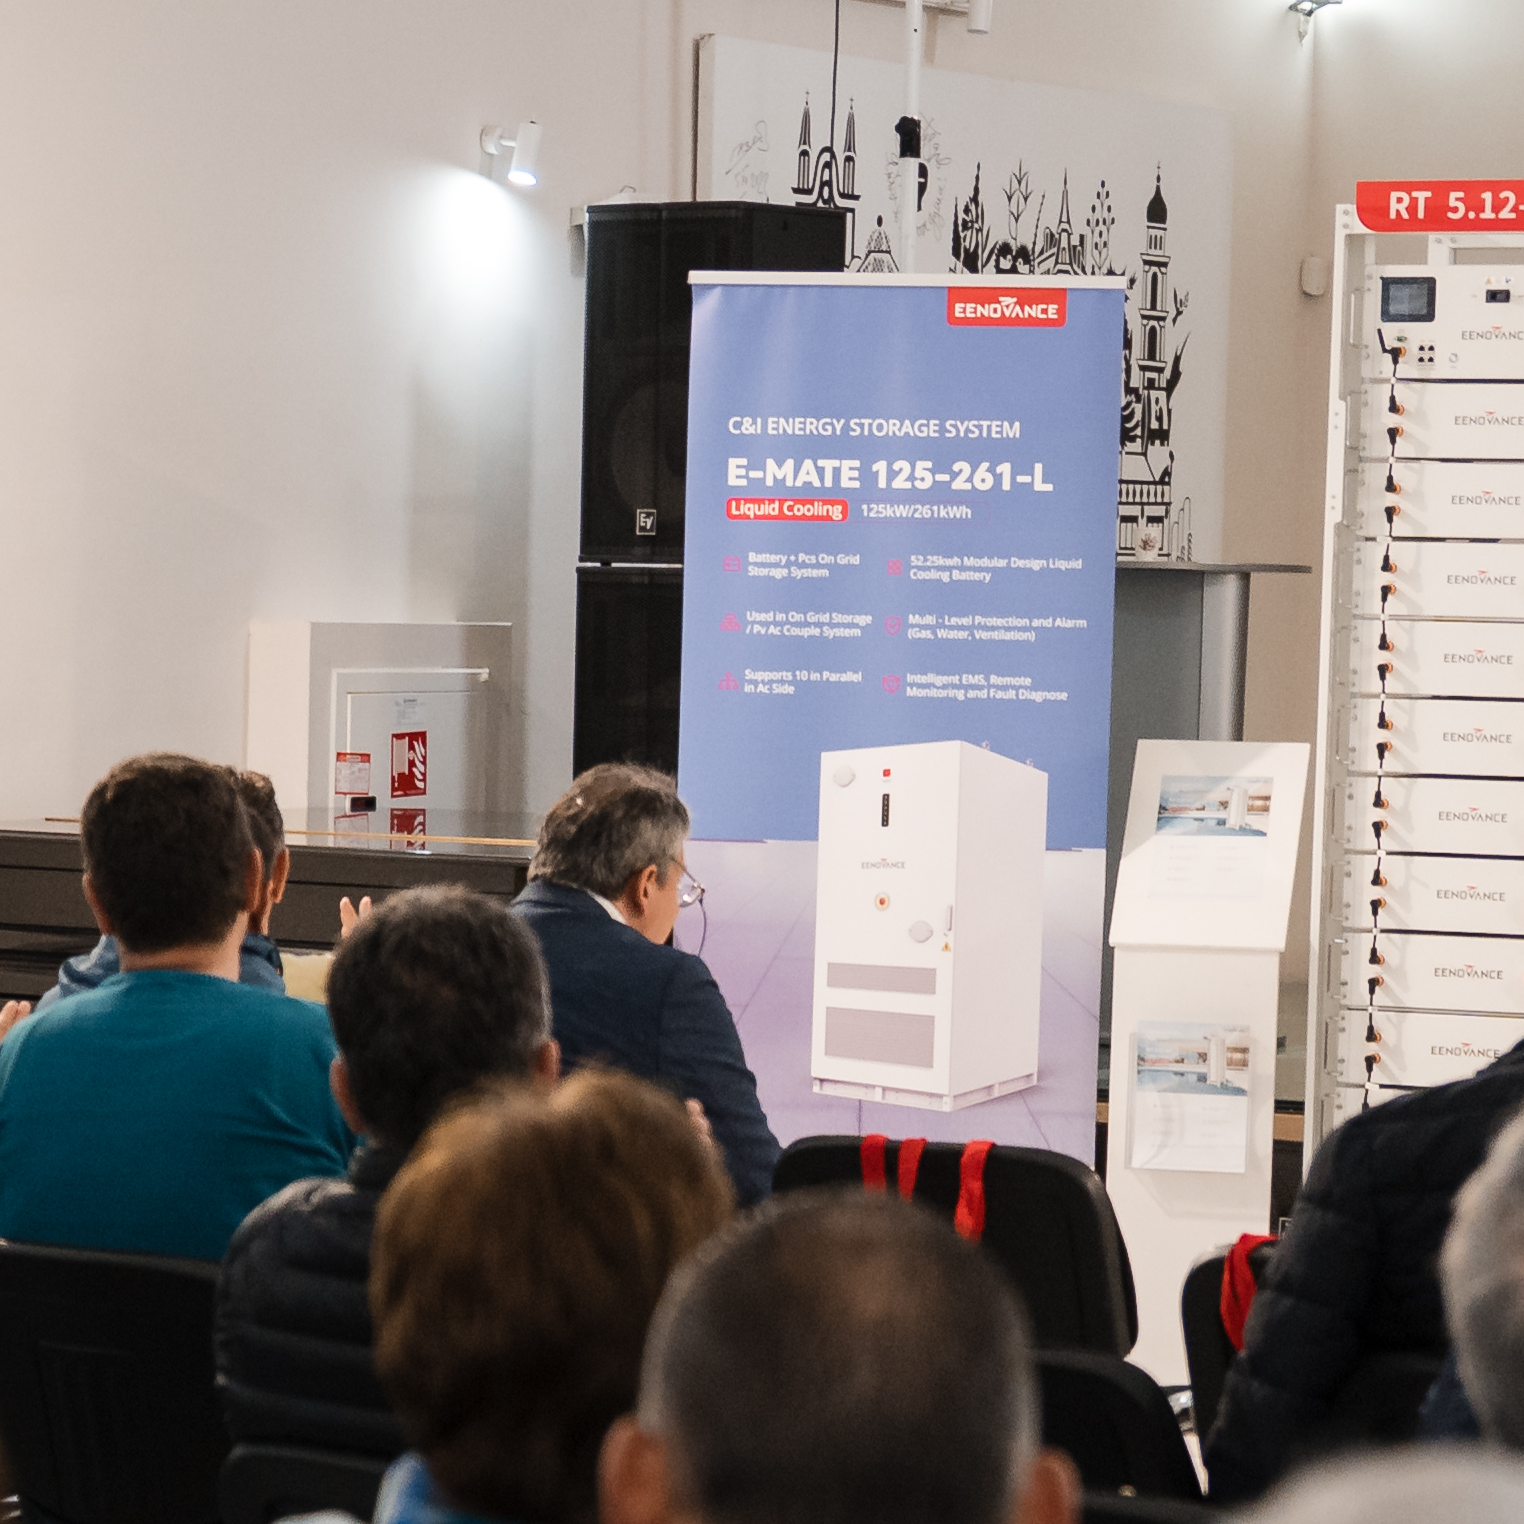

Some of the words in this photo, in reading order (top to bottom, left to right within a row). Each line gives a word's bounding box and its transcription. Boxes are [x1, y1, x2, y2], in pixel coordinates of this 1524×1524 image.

[1389, 190, 1432, 220] RT
[954, 296, 1059, 319] EENOVANCE
[1454, 411, 1524, 427] EENOVANCE
[728, 416, 762, 435] C&I
[767, 417, 845, 436] ENERGY
[849, 418, 940, 437] STORAGE
[944, 419, 1021, 439] SYSTEM
[727, 457, 861, 489] E-MATE
[871, 459, 1054, 492] 125-261-L
[1451, 491, 1521, 506] EENOVANCE
[730, 499, 779, 519] Liquid
[782, 500, 843, 520] Cooling
[861, 503, 972, 519] 125kW/261kWh
[748, 552, 787, 566] Battery
[798, 553, 816, 564] Pcs
[818, 553, 835, 564] On
[836, 554, 860, 565] Grid
[910, 555, 962, 567] 52.25kwh
[963, 556, 1008, 568] Modular
[1010, 557, 1047, 571] Design
[1049, 558, 1083, 571] Liquid
[747, 565, 789, 579] Storage
[790, 567, 830, 580] System
[909, 569, 950, 583] Cooling
[951, 570, 992, 584] Battery
[1446, 570, 1517, 586] EENOVANCE
[746, 611, 774, 622] Used
[787, 612, 805, 623] On
[806, 612, 830, 624] Grid
[831, 613, 873, 627] Storage
[908, 614, 936, 626] Multi
[944, 615, 972, 627] Level
[975, 615, 1030, 628] Protection
[1031, 617, 1053, 628] and
[1055, 617, 1088, 629] Alarm
[753, 625, 767, 636] Pv
[767, 625, 781, 636] Ac
[783, 625, 820, 639] Couple
[822, 626, 862, 640] System
[907, 627, 935, 641] (Gas,
[936, 629, 972, 641] Water,
[974, 630, 1036, 643] Ventilation)
[1443, 650, 1514, 665] EENOVANCE
[744, 669, 792, 682] Supports
[795, 671, 808, 681] 10
[822, 671, 862, 682] Parallel
[906, 673, 960, 687] Intelligent
[990, 675, 1032, 686] Remote
[756, 683, 770, 693] Ac
[772, 683, 795, 694] Side
[906, 687, 965, 700] Monitoring
[967, 689, 988, 699] and
[990, 689, 1016, 700] Fault
[1018, 690, 1068, 702] Diagnose
[1442, 728, 1513, 744] EENOVANCE
[1438, 807, 1508, 823] EENOVANCE
[861, 858, 906, 870] EENOVANCE
[1436, 886, 1506, 902] EENOVANCE
[1433, 964, 1504, 980] EENOVANCE
[1430, 1042, 1501, 1059] EENOVANCE
